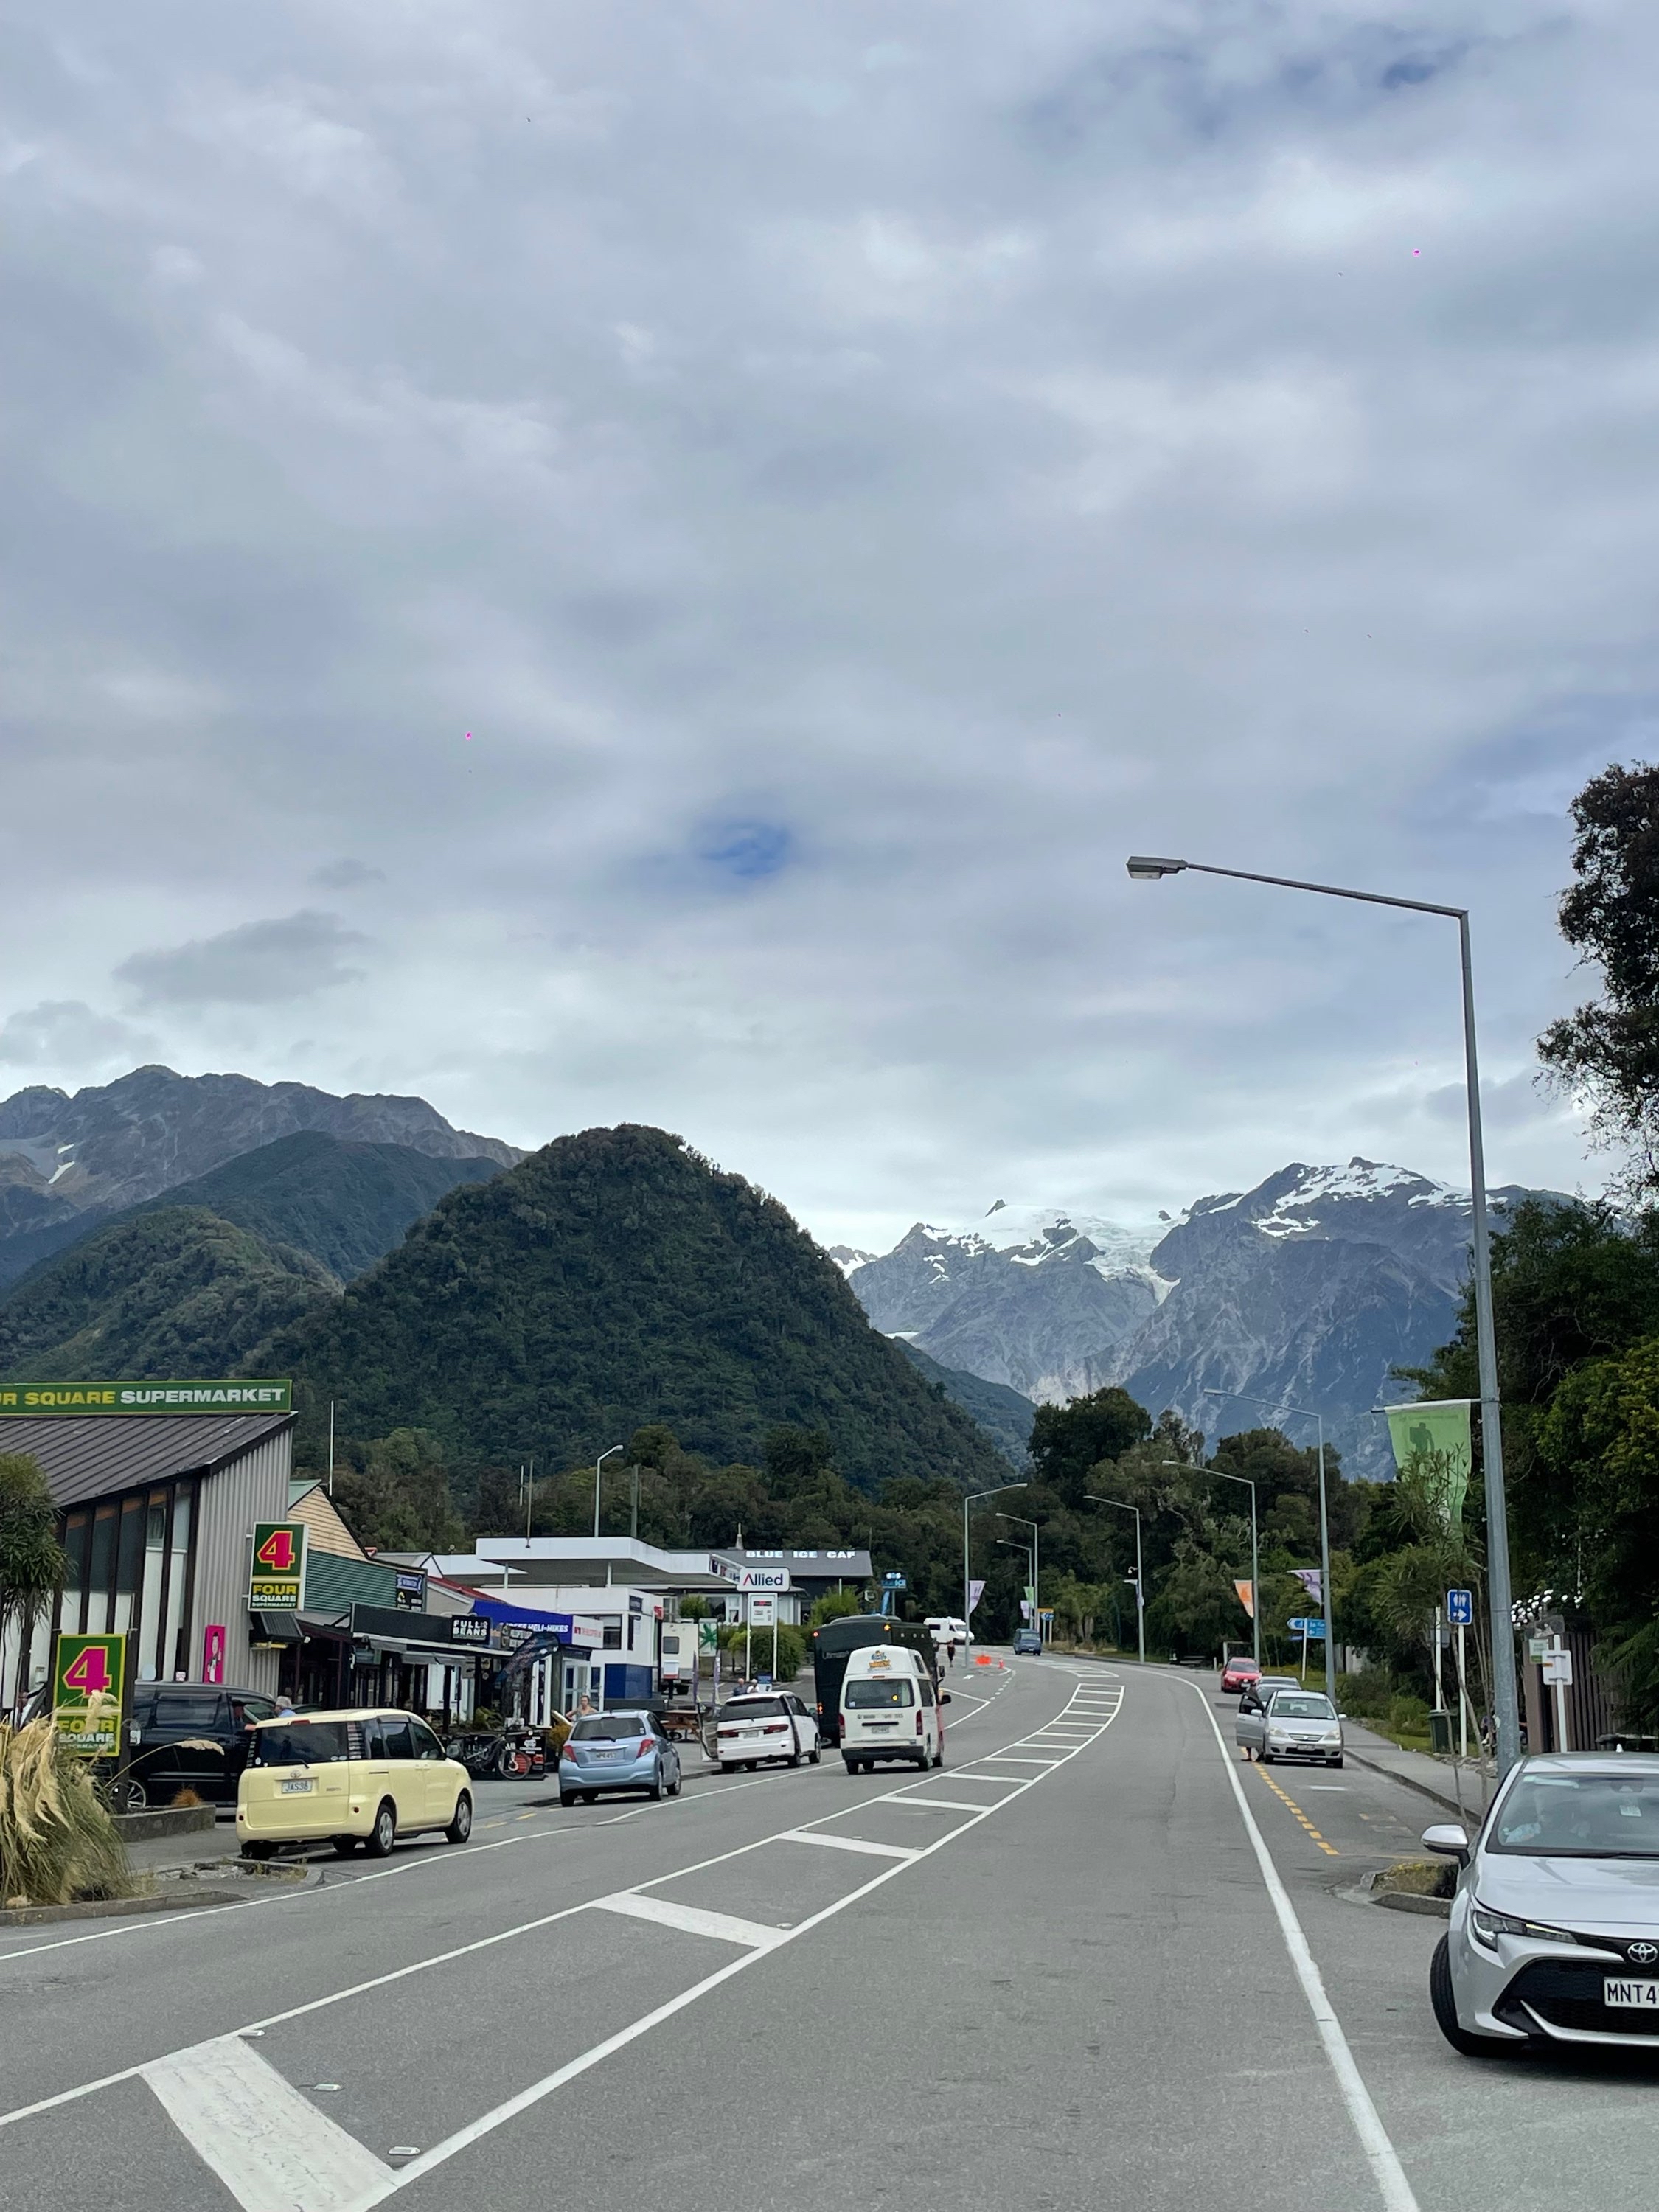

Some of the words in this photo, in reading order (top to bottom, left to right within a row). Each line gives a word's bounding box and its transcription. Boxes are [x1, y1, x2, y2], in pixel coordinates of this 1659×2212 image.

[0, 1392, 17, 1405] R
[24, 1391, 115, 1406] SQUARE
[120, 1388, 285, 1404] SUPERMARKET
[257, 1531, 295, 1570] 4
[743, 1573, 783, 1586] Allied
[253, 1585, 296, 1595] FOUR
[453, 1620, 481, 1628] FULL
[453, 1627, 487, 1636] BEANS
[62, 1646, 112, 1698] 4
[58, 1720, 114, 1733] FOR
[1607, 1983, 1659, 2004] MNT4
